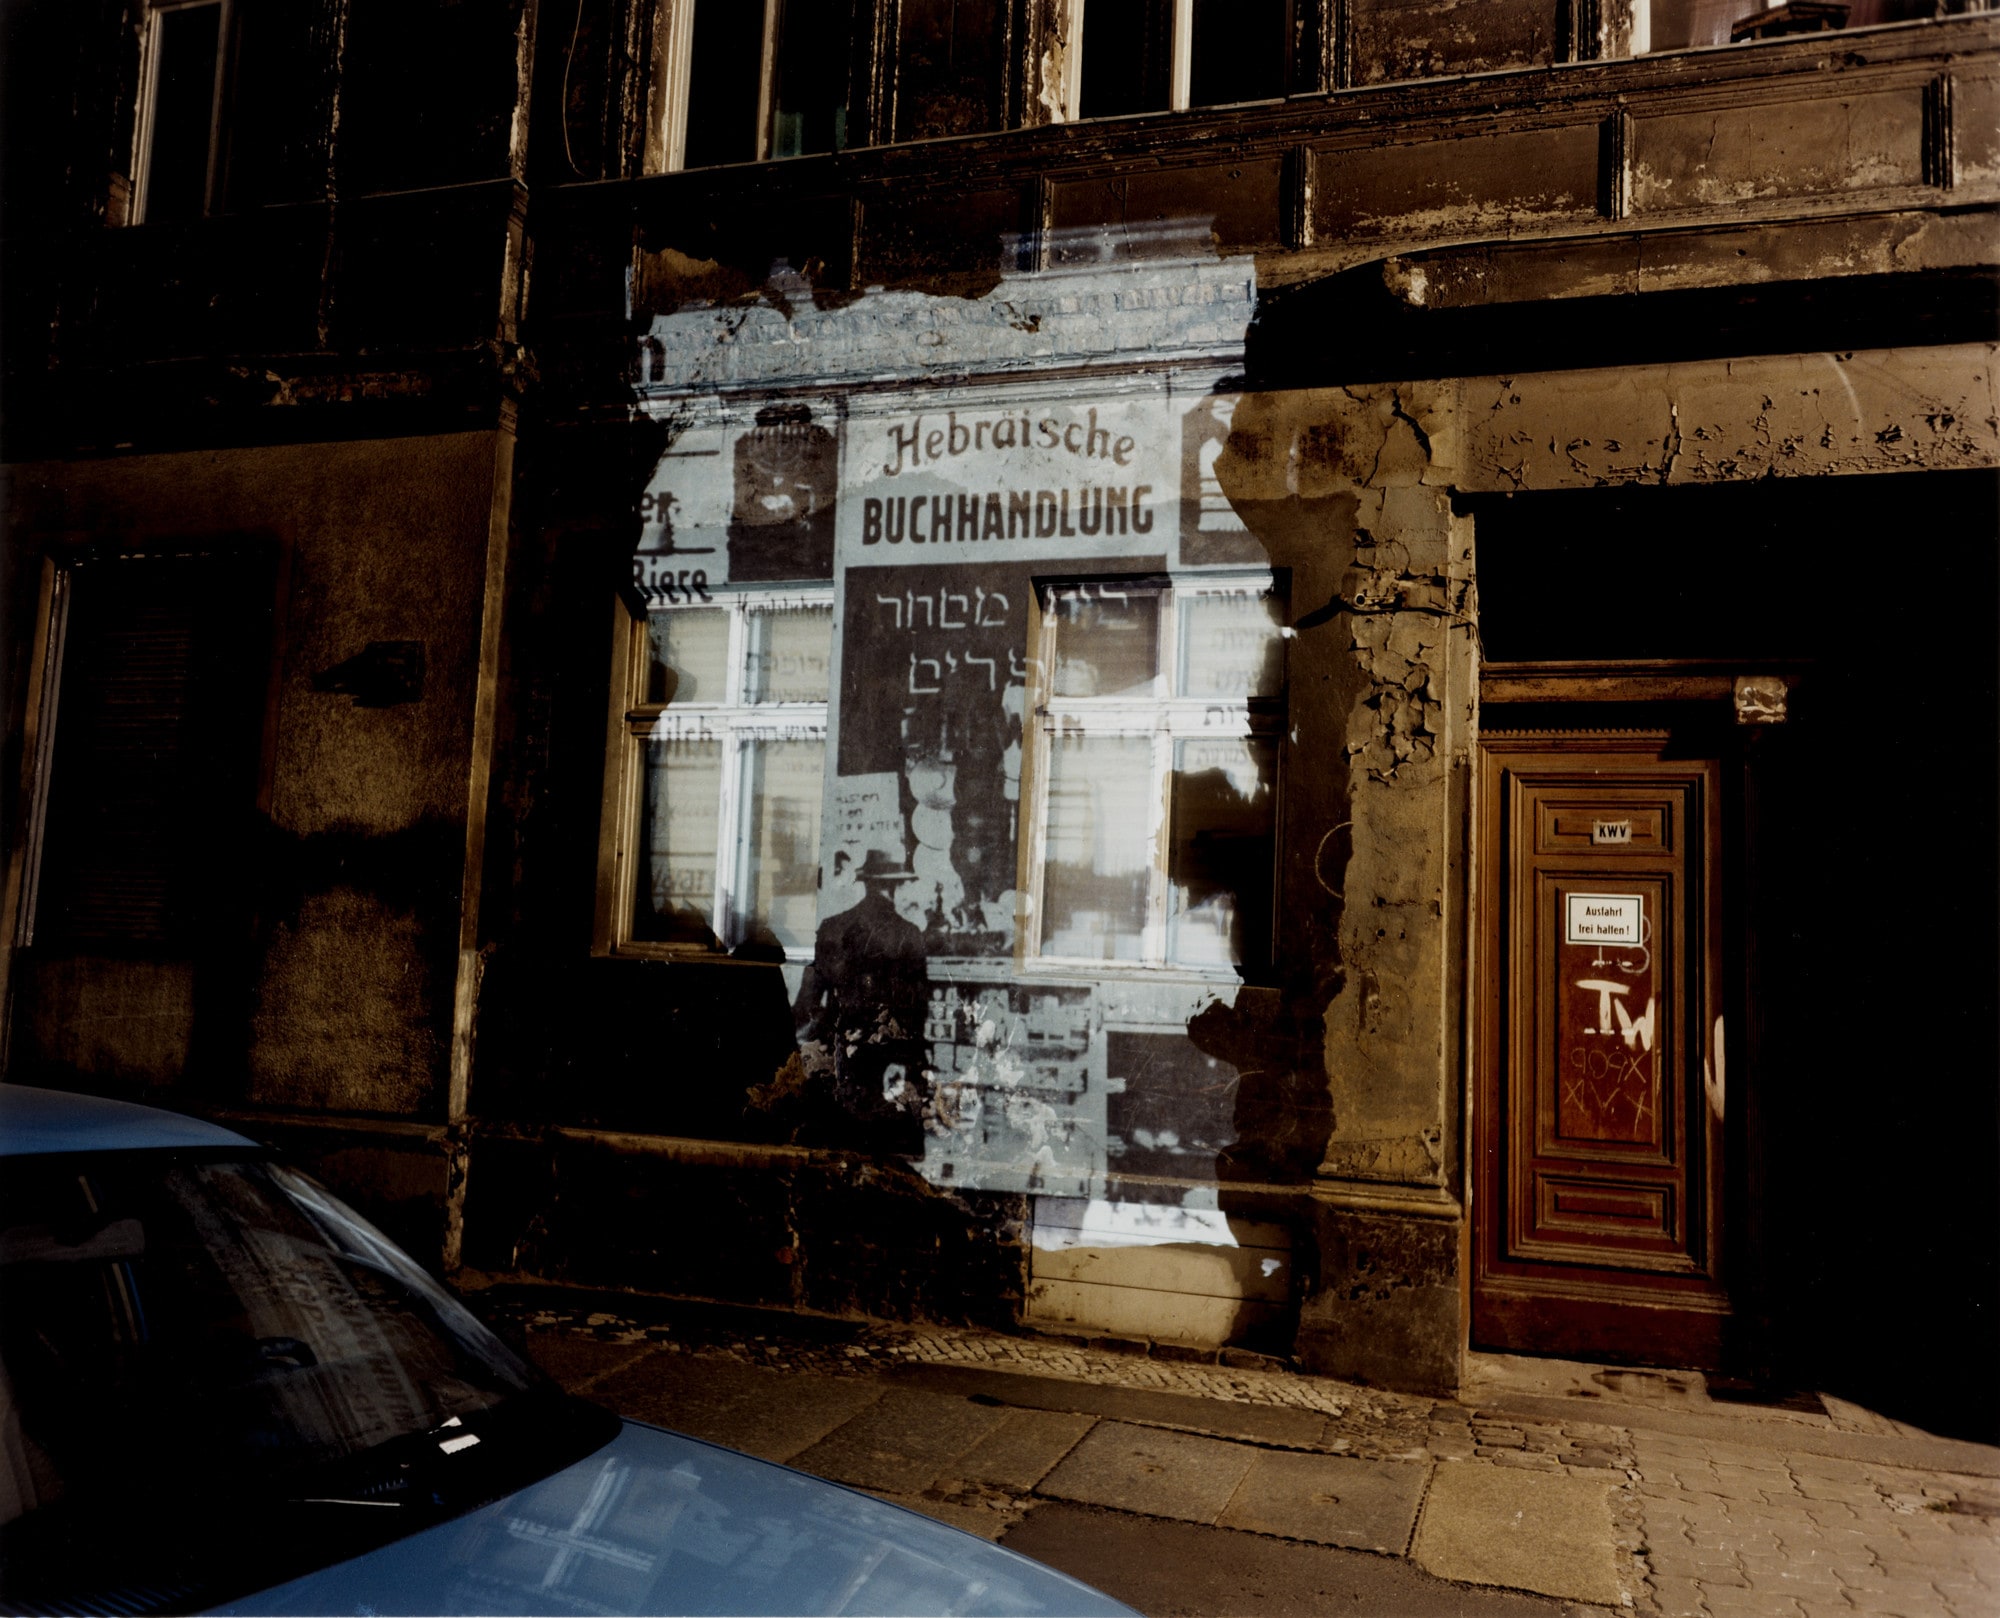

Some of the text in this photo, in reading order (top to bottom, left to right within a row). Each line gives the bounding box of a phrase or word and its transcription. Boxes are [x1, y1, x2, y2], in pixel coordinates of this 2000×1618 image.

[862, 485, 1153, 545] BUCHHANDLUNG
[1598, 824, 1627, 838] KWV
[1586, 905, 1622, 917] Ausfahrt
[1578, 923, 1594, 934] frei
